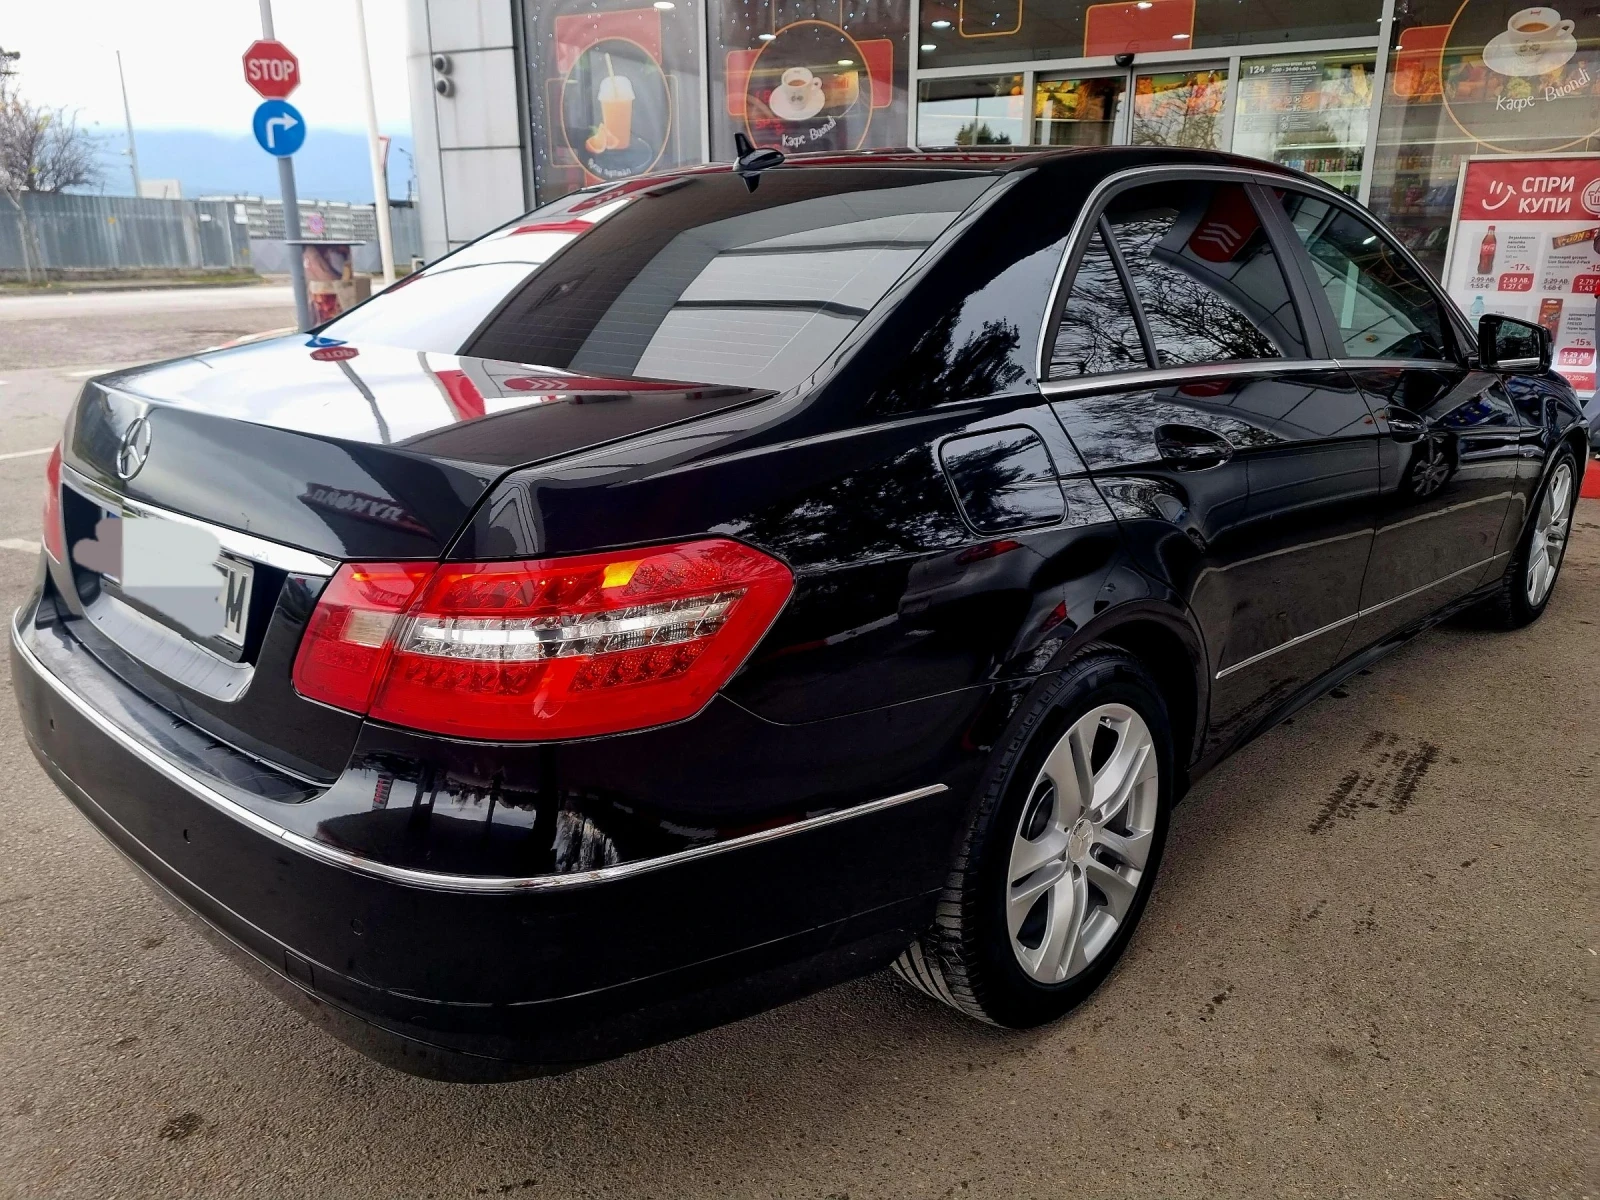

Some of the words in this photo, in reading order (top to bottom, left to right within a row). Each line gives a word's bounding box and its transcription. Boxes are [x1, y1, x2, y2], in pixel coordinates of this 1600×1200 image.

[249, 58, 295, 81] STOP
[1250, 65, 1265, 75] 124
[1495, 95, 1536, 112] Кафе
[1545, 67, 1591, 102] Buondi
[1522, 176, 1575, 193] СПРИ
[1518, 197, 1571, 213] КУПИ
